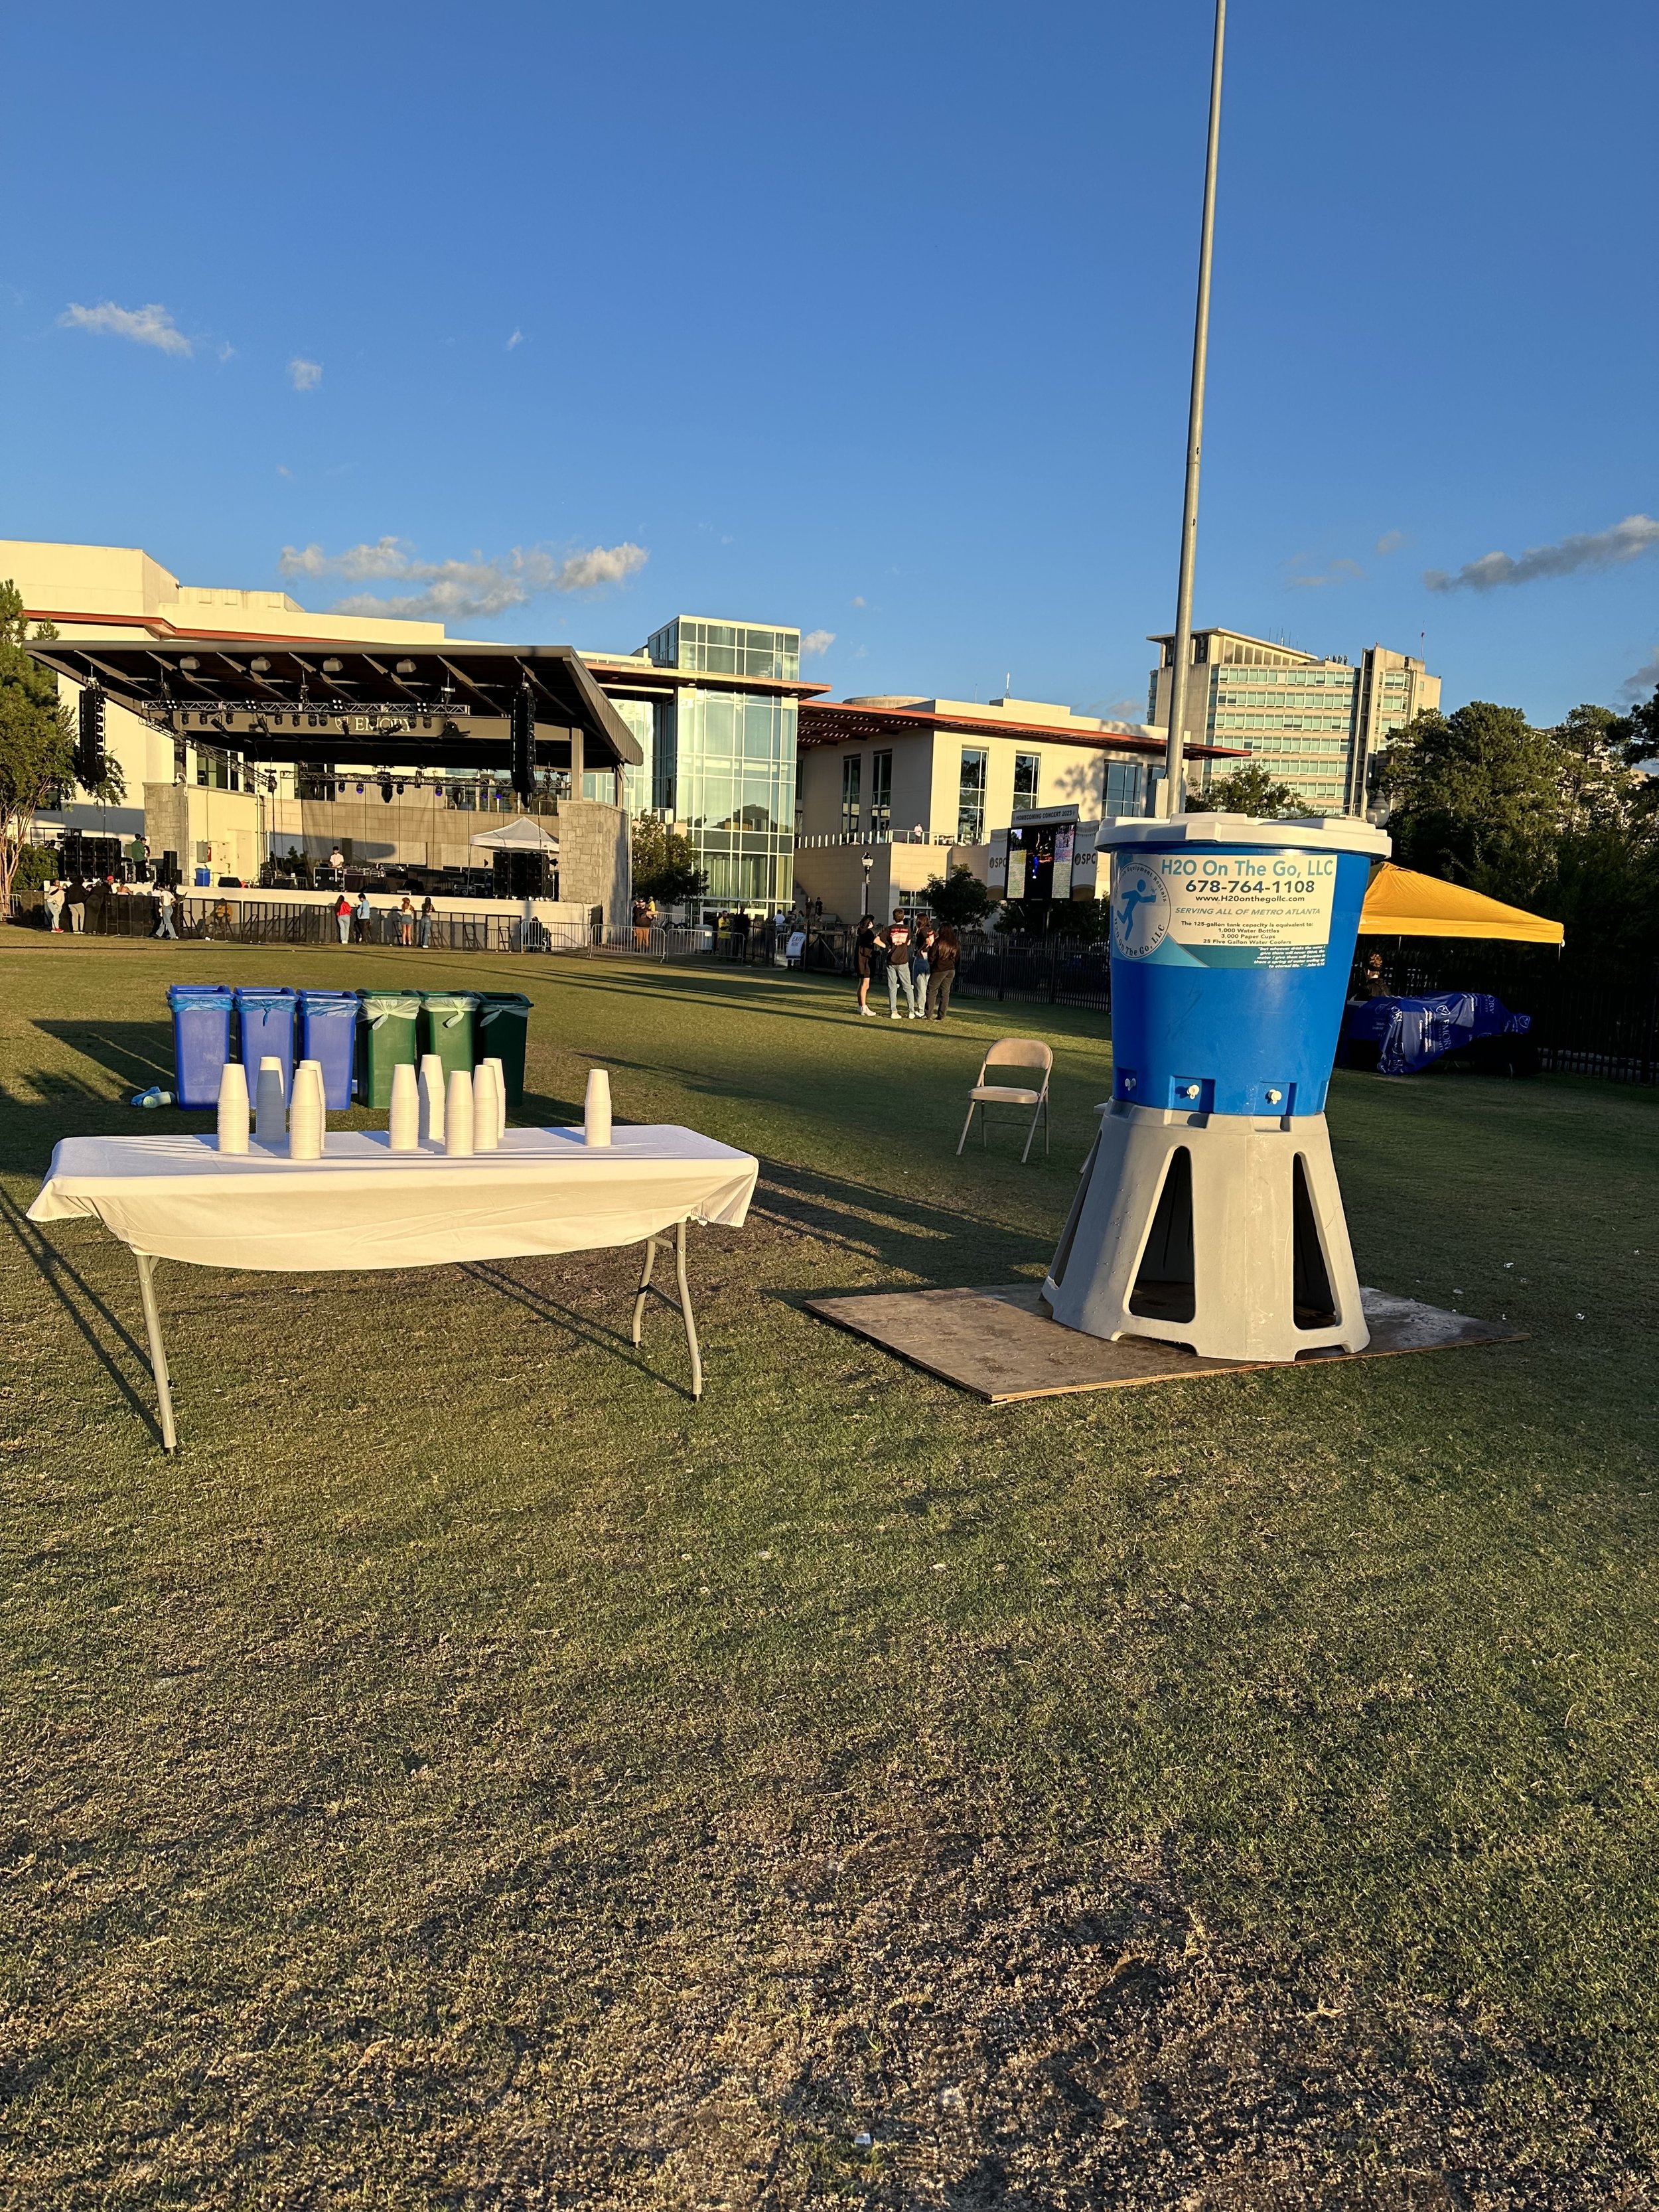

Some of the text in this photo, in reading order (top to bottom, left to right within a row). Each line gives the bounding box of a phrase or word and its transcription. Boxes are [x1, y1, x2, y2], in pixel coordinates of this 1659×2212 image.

[1161, 859, 1333, 878] H2O On The Go, LLC
[1127, 865, 1167, 902] Equipment Rentals
[1185, 879, 1315, 893] 678-764-1108
[1125, 946, 1137, 956] The
[1151, 924, 1165, 944] LLC
